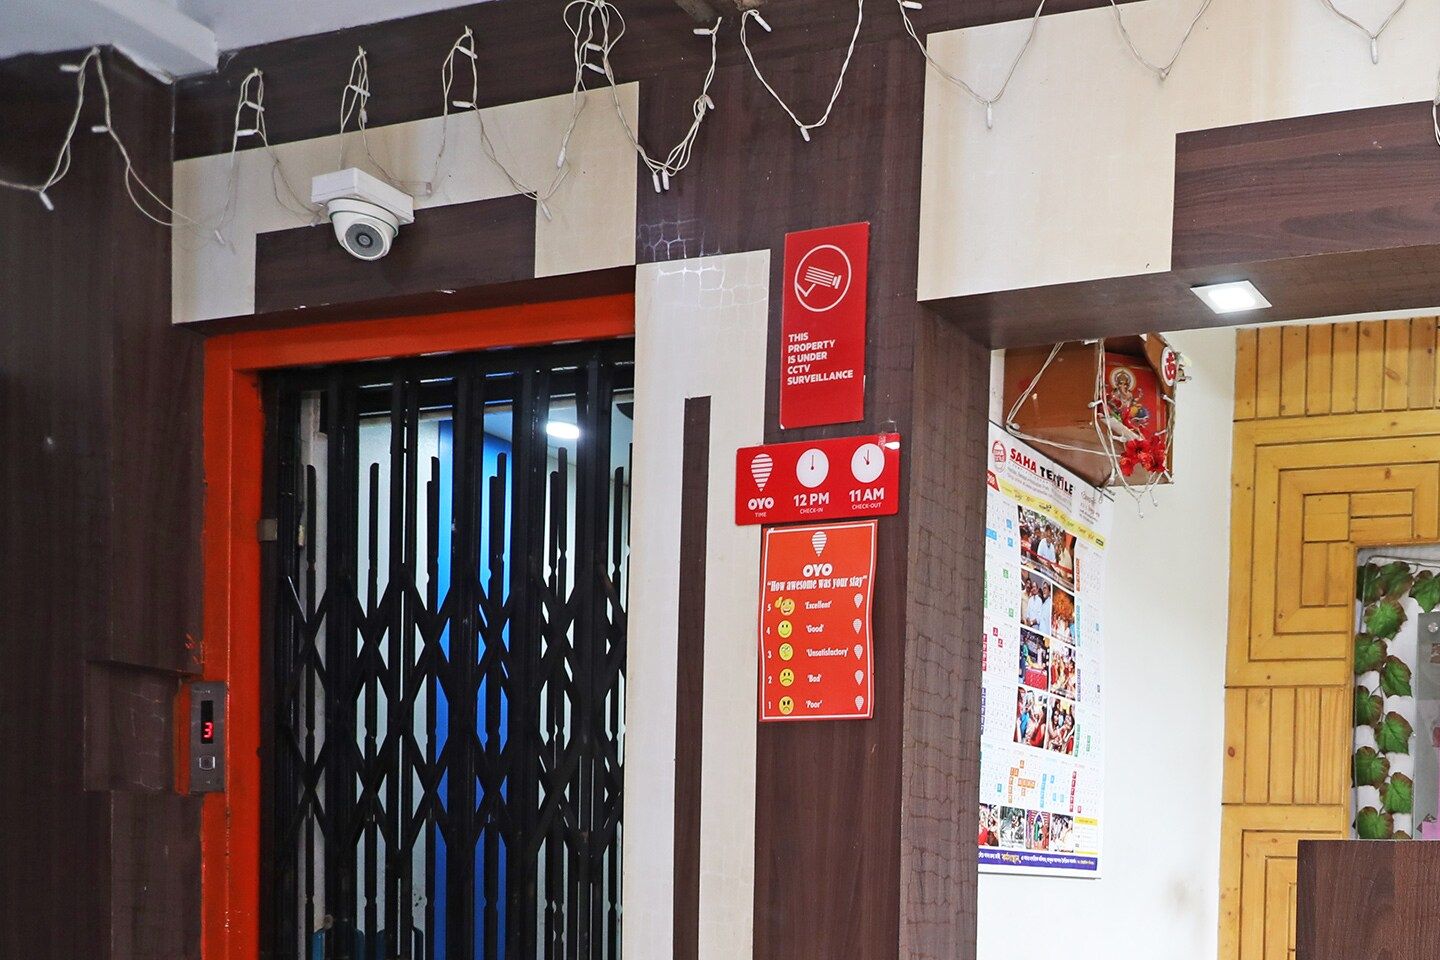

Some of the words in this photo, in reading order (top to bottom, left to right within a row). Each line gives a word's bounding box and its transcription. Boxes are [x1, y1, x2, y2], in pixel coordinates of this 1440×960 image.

[788, 332, 809, 342] THIS
[788, 339, 836, 353] PROPERTY
[787, 355, 796, 364] IS
[797, 351, 828, 363] UNDER
[787, 364, 811, 374] CCTV
[787, 369, 854, 385] SURVEILLANCE
[1010, 448, 1037, 473] SAHA
[793, 494, 807, 507] 12
[809, 492, 830, 506] PM
[848, 489, 861, 502] 11
[863, 487, 885, 501] AM
[747, 497, 775, 511] OYO
[800, 507, 824, 515] CHECK-IN
[851, 502, 882, 510] CHECK-OUT
[803, 563, 833, 577] OYO
[786, 579, 817, 591] awesome
[818, 578, 831, 589] was
[832, 577, 848, 590] your
[766, 627, 771, 635] 4
[767, 650, 772, 659] 3
[767, 675, 772, 684] 2
[204, 722, 213, 738] 3
